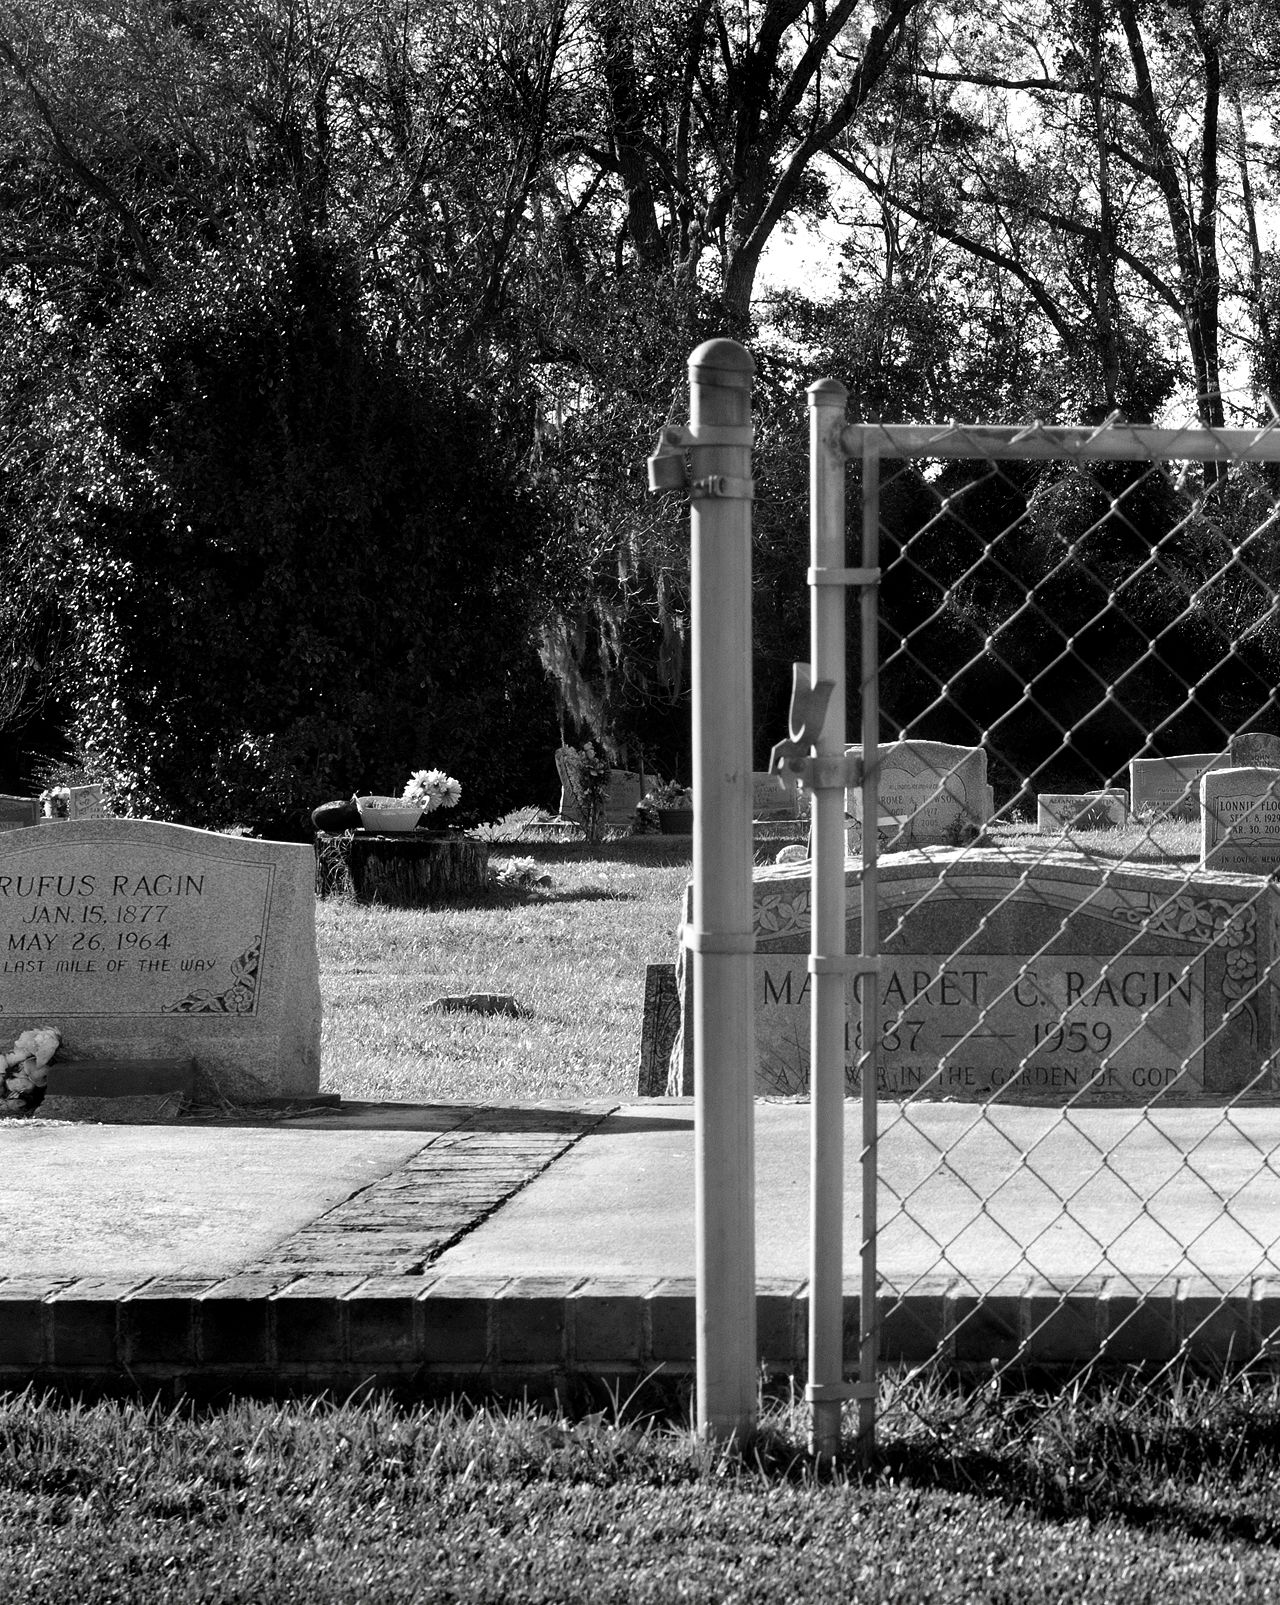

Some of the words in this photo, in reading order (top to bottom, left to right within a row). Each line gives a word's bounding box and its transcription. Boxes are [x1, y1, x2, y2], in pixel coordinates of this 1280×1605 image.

[1220, 801, 1256, 812] LONNIE
[1264, 813, 1280, 823] 1929
[0, 874, 96, 898] RUFUS
[112, 874, 205, 898] RAGIN
[22, 905, 75, 924] JAN.
[116, 904, 169, 924] 1877
[8, 932, 58, 951] MAY
[117, 931, 171, 951] 1964
[3, 960, 46, 973] LAST
[56, 959, 98, 973] MILE
[106, 959, 128, 973] OF
[138, 959, 171, 973] THE
[180, 957, 217, 972] WAY
[1013, 971, 1047, 1008] C.
[1065, 971, 1193, 1008] RAGIN
[1032, 1021, 1113, 1054] 1959
[776, 1065, 790, 1085] A
[901, 1066, 921, 1085] IN
[936, 1066, 976, 1086] THE
[990, 1067, 1078, 1087] GARDEN
[1091, 1067, 1119, 1087] OF
[1132, 1067, 1178, 1087] GOD
